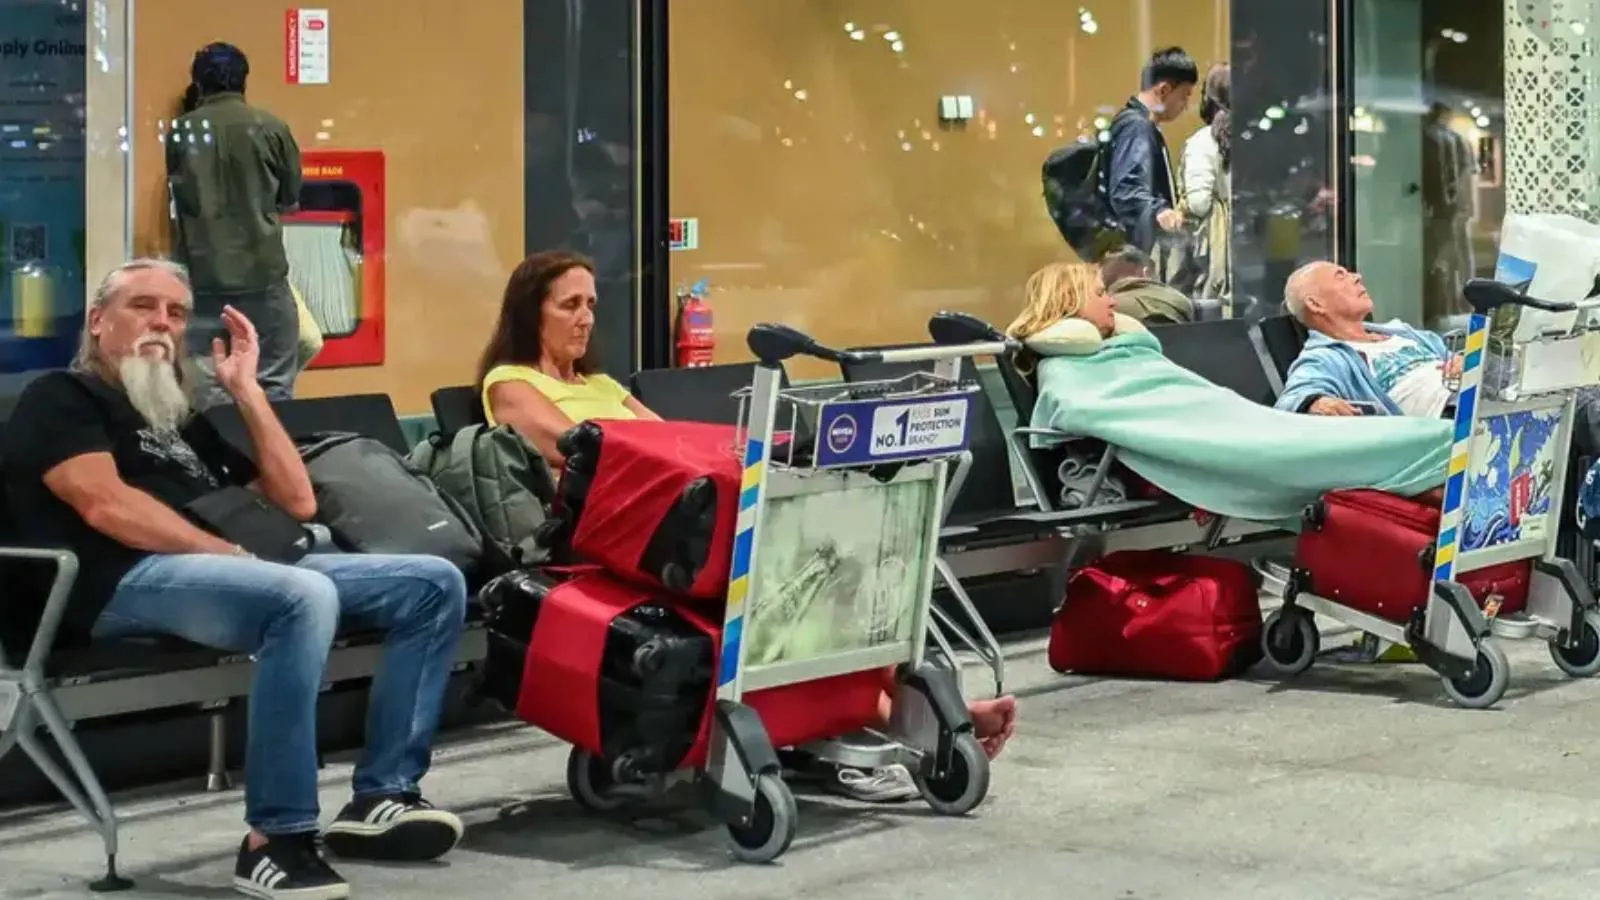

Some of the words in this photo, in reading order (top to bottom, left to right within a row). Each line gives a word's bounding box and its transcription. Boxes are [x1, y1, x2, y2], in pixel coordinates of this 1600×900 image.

[0, 38, 28, 59] ply
[876, 433, 897, 448] NO.
[896, 408, 910, 446] 1
[909, 418, 961, 432] PROTECTION
